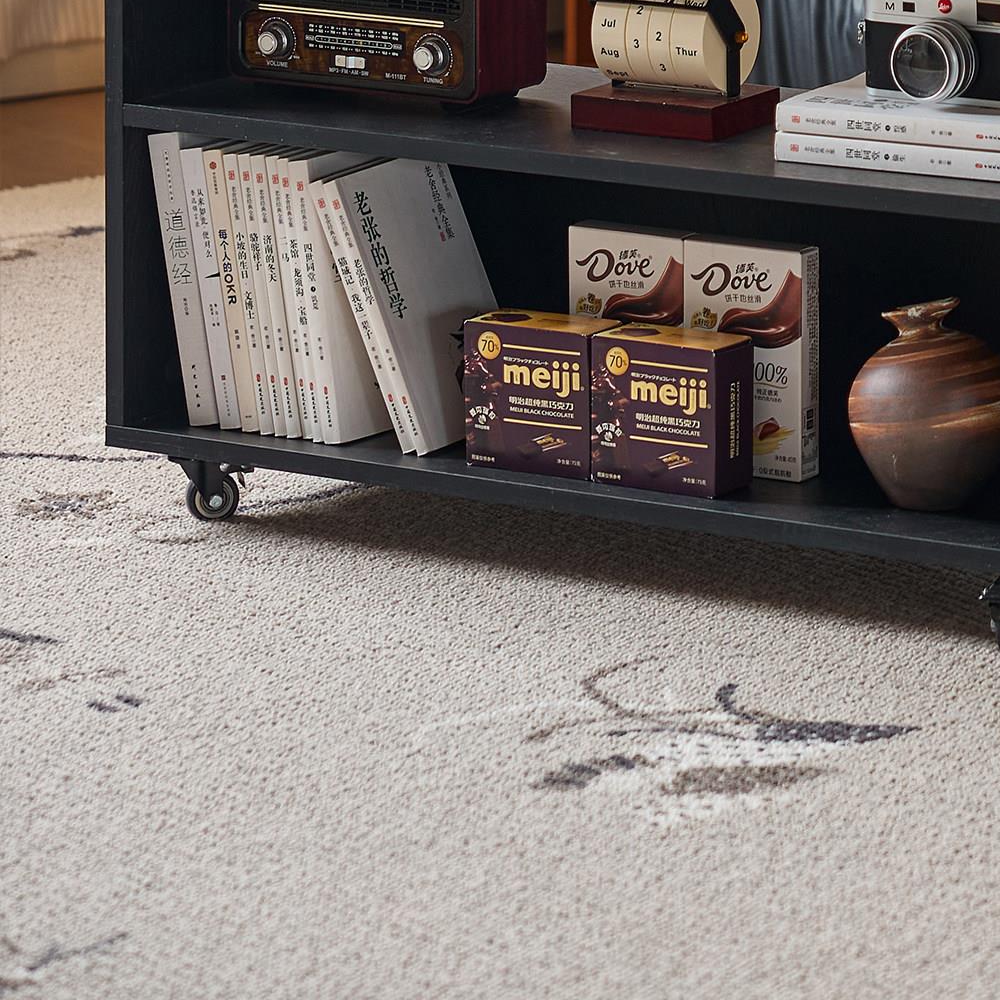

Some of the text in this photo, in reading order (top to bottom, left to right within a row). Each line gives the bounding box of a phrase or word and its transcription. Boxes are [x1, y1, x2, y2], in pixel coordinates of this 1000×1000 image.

[636, 5, 644, 15] 2
[885, 2, 895, 10] M
[601, 18, 616, 28] Jul
[633, 39, 640, 48] 3
[655, 31, 662, 41] 2
[600, 47, 619, 58] Aug
[675, 47, 698, 56] Thur
[266, 60, 288, 68] VOLUME
[660, 63, 666, 72] 3
[423, 77, 443, 85] TUNING
[165, 208, 193, 285] 道德经
[250, 232, 262, 271] 骆驼祥子
[263, 234, 277, 283] 济南的冬天
[304, 243, 317, 282] 四世同堂
[353, 191, 407, 319] 老张的哲学
[218, 229, 237, 305] 每个人的OKR
[576, 248, 655, 282] Dove
[690, 262, 772, 296] Dove
[503, 361, 581, 397] meiji
[753, 361, 788, 385] 00%
[508, 396, 574, 411] 明治超纯黑巧克力
[630, 377, 707, 416] meiji
[524, 408, 541, 416] BLACK
[541, 410, 574, 419] CHOCOLATE
[635, 412, 701, 429] 明治超纯黑巧克力
[650, 424, 668, 433] BLACK
[668, 427, 701, 437] CHOCOLATE
